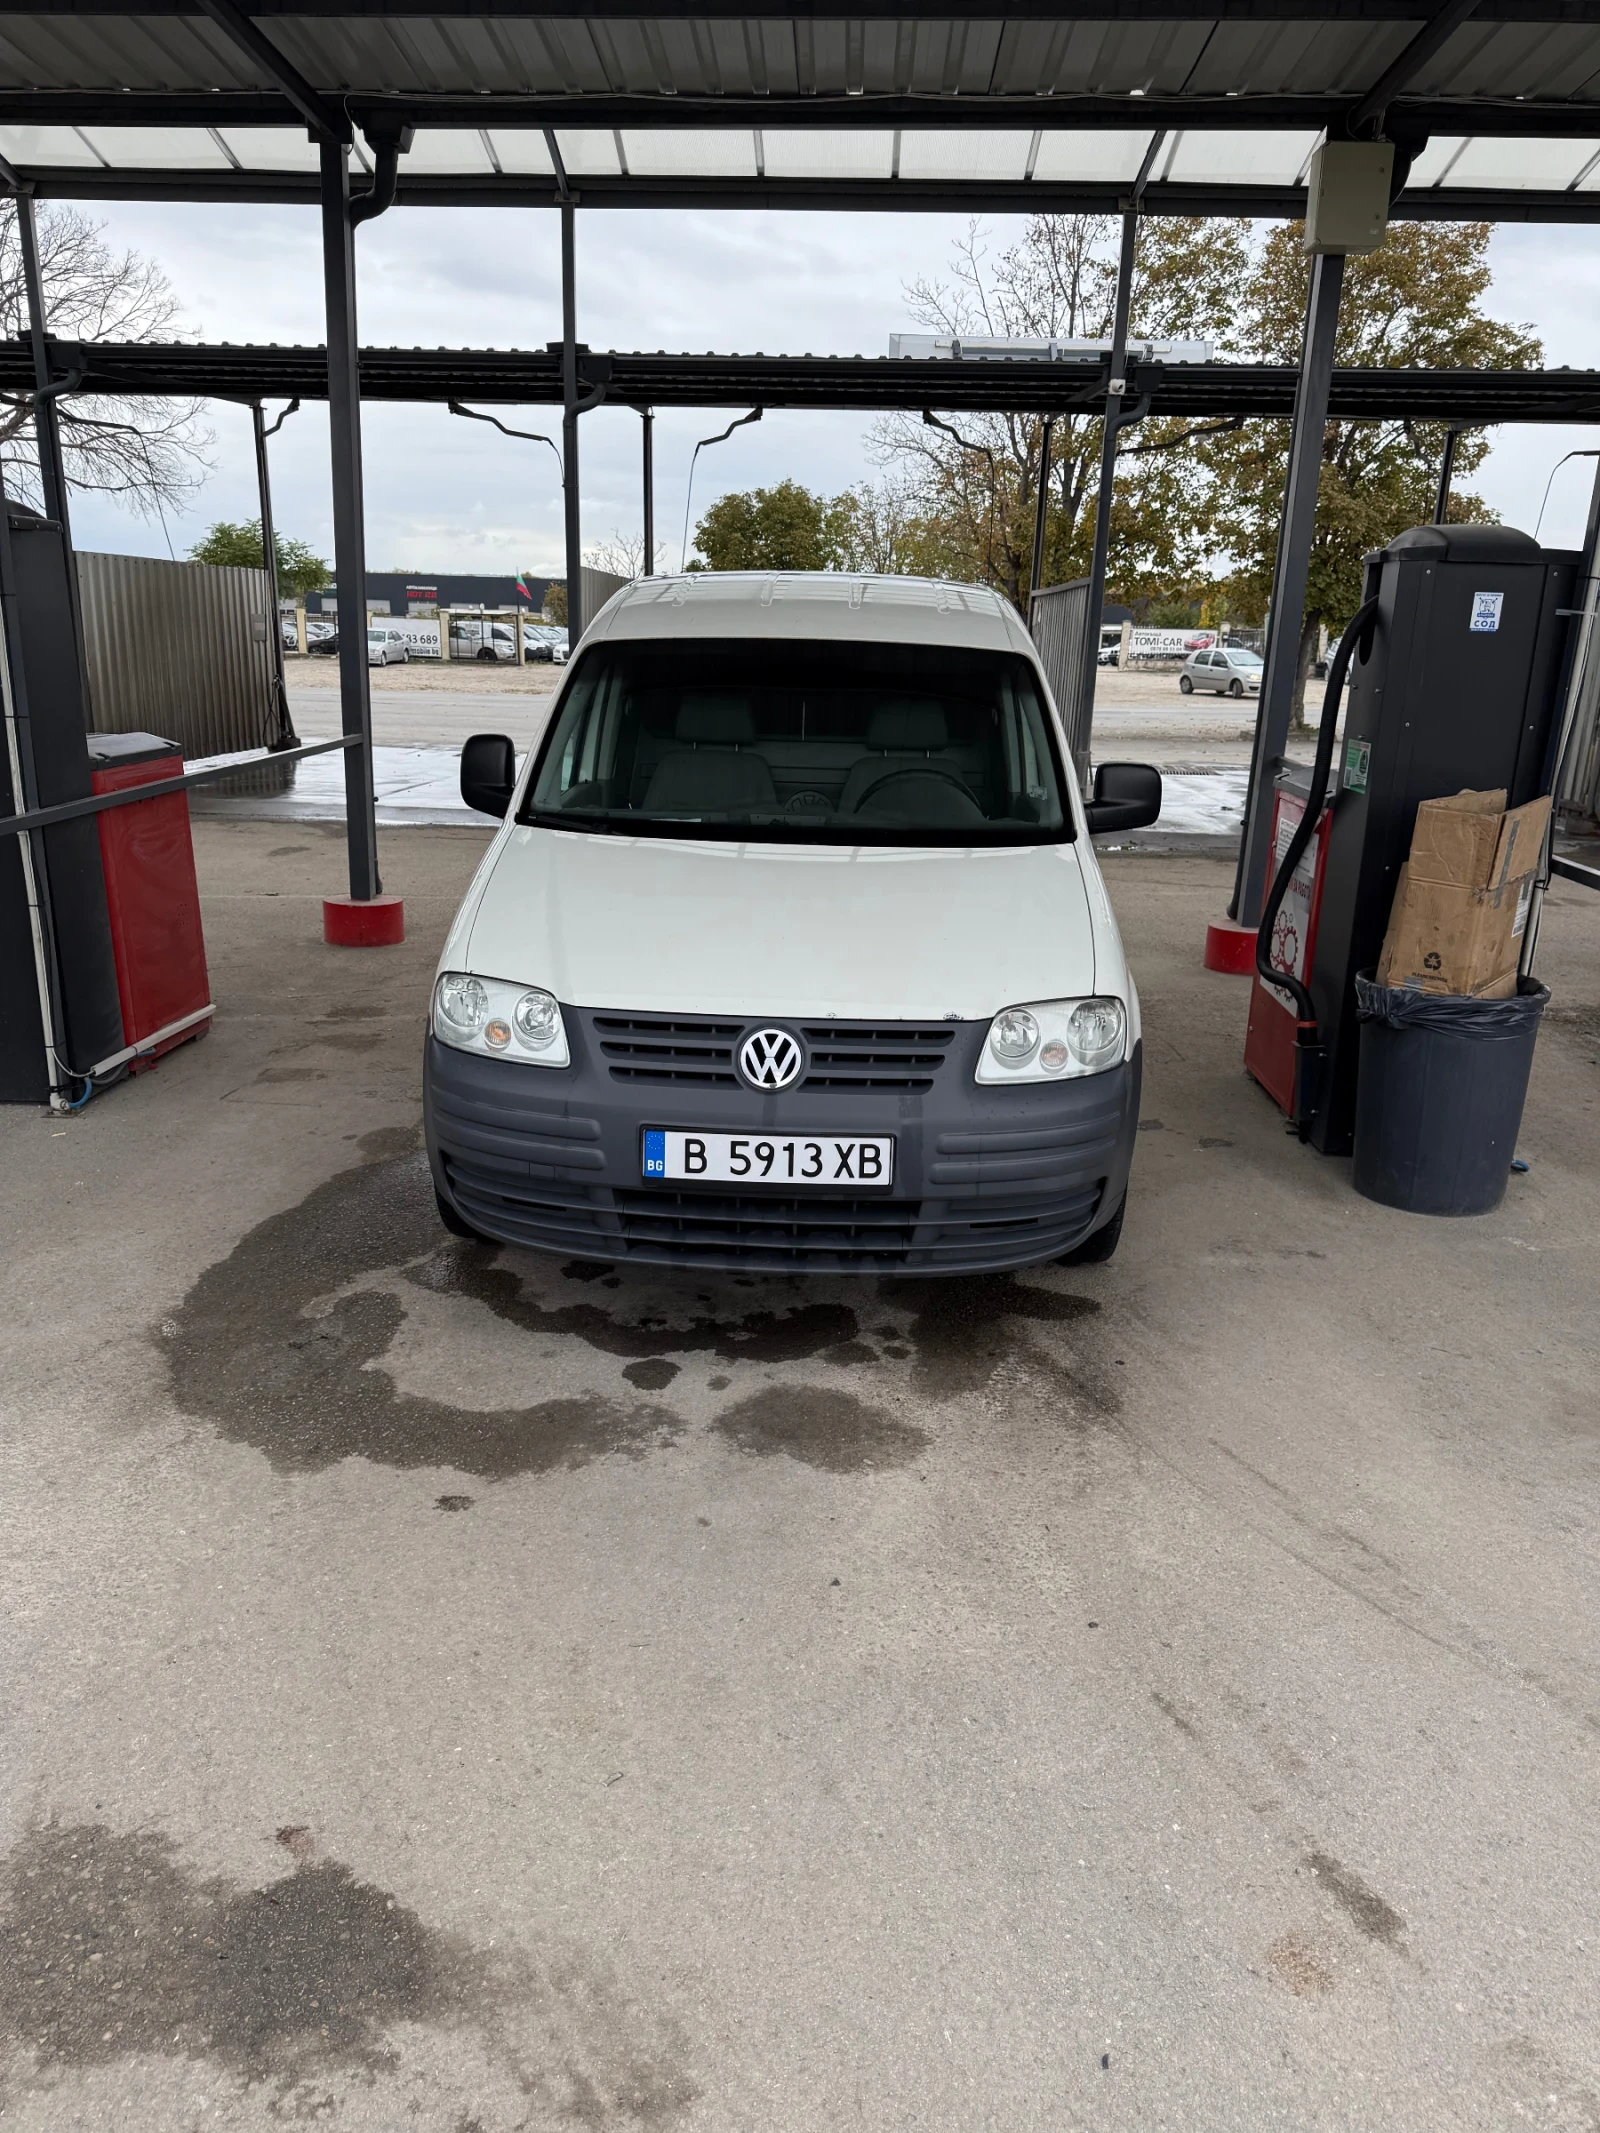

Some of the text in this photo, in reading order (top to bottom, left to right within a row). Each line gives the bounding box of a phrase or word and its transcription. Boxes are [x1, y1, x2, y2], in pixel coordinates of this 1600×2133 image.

[1474, 620, 1495, 628] СОД
[420, 635, 438, 644] 689
[1134, 637, 1182, 646] TOMI-CAR
[684, 1138, 883, 1179] B 5913 XB
[647, 1159, 663, 1171] BG
